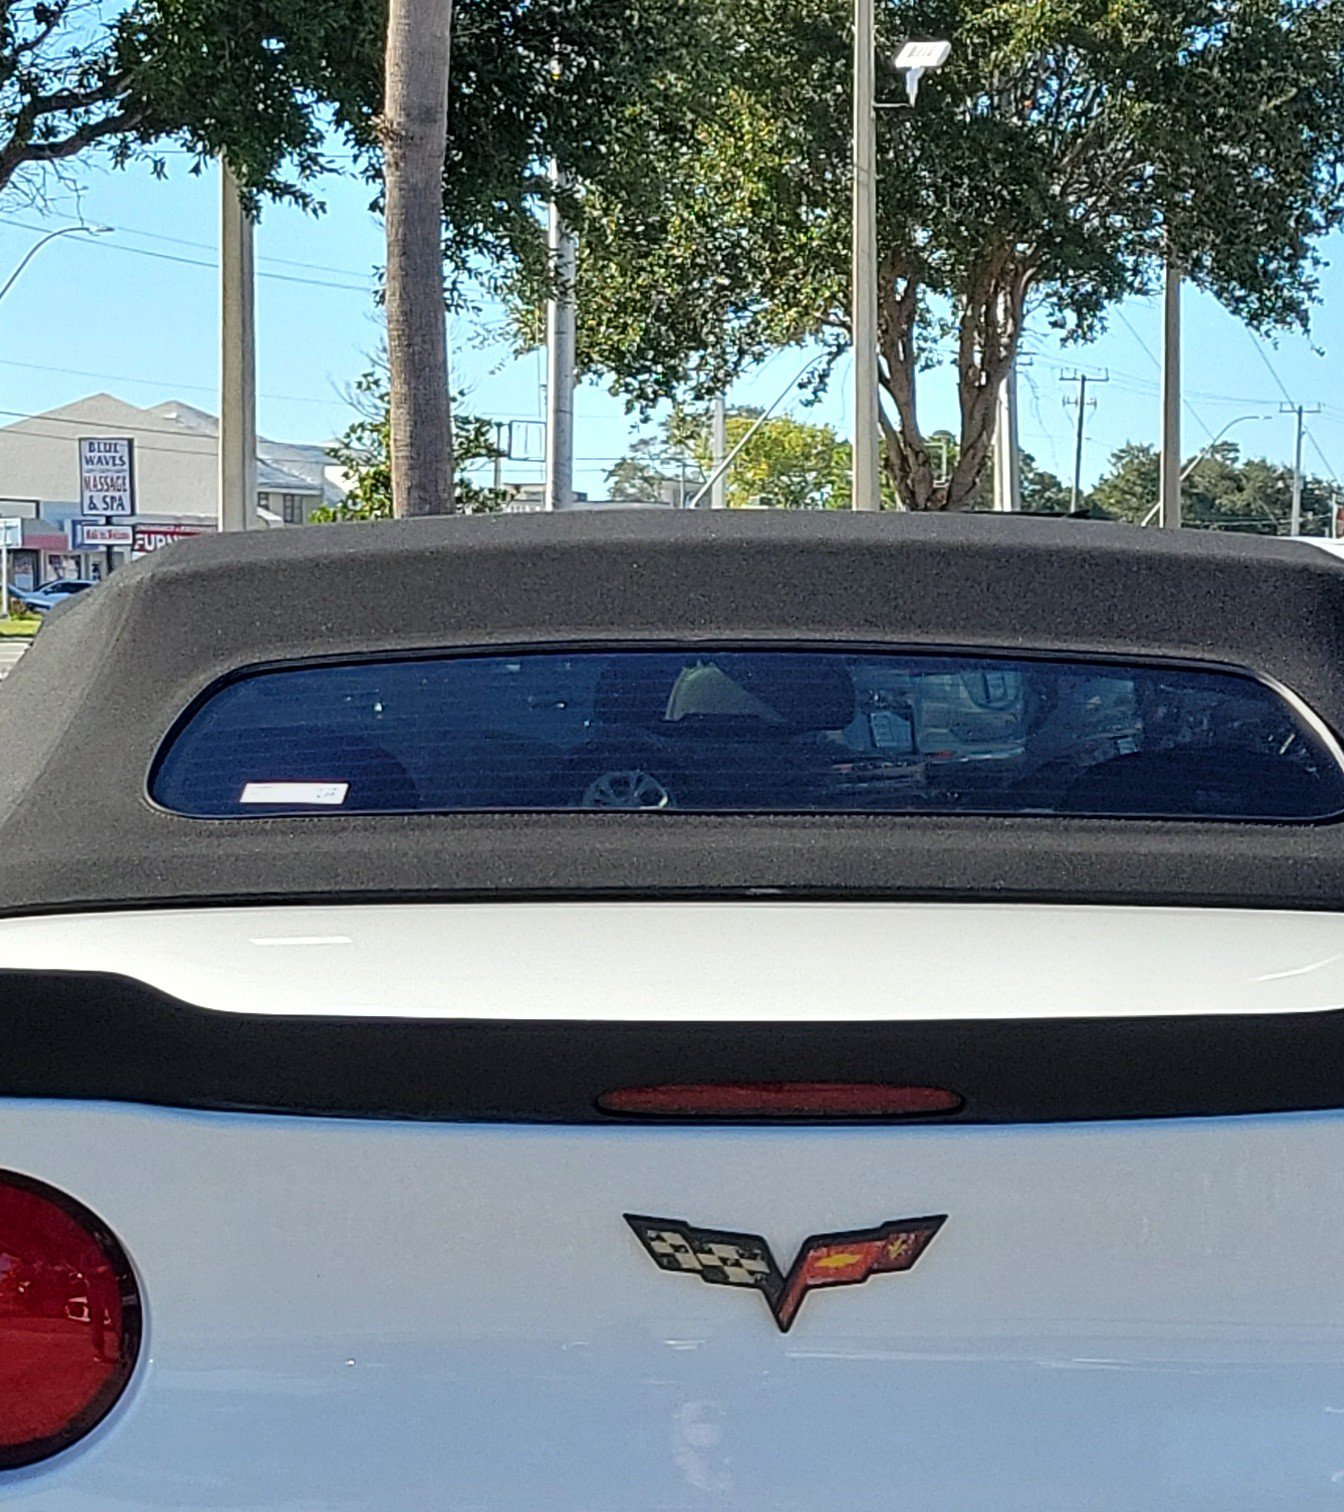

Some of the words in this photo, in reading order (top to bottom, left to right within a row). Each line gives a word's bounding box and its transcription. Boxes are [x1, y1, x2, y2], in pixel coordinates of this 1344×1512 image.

[88, 441, 120, 453] BLUE
[84, 455, 126, 467] WAVES
[84, 475, 128, 492] MASSAGE
[87, 495, 100, 511] &
[102, 495, 126, 511] SPA
